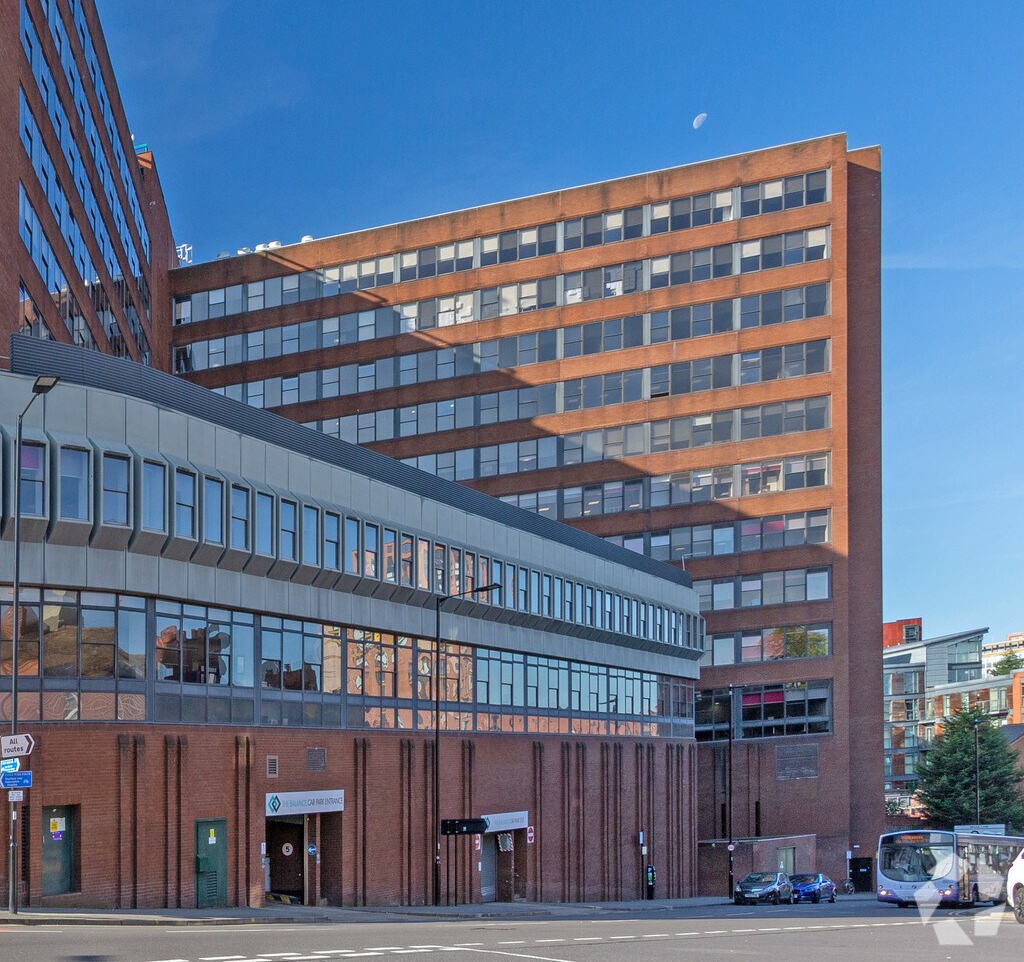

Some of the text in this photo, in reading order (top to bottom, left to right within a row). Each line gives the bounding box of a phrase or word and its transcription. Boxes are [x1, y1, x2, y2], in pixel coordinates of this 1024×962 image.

[289, 799, 307, 807] BALANCE
[307, 798, 316, 806] CAR
[325, 797, 343, 805] ENTRANCE
[285, 845, 290, 853] 5
